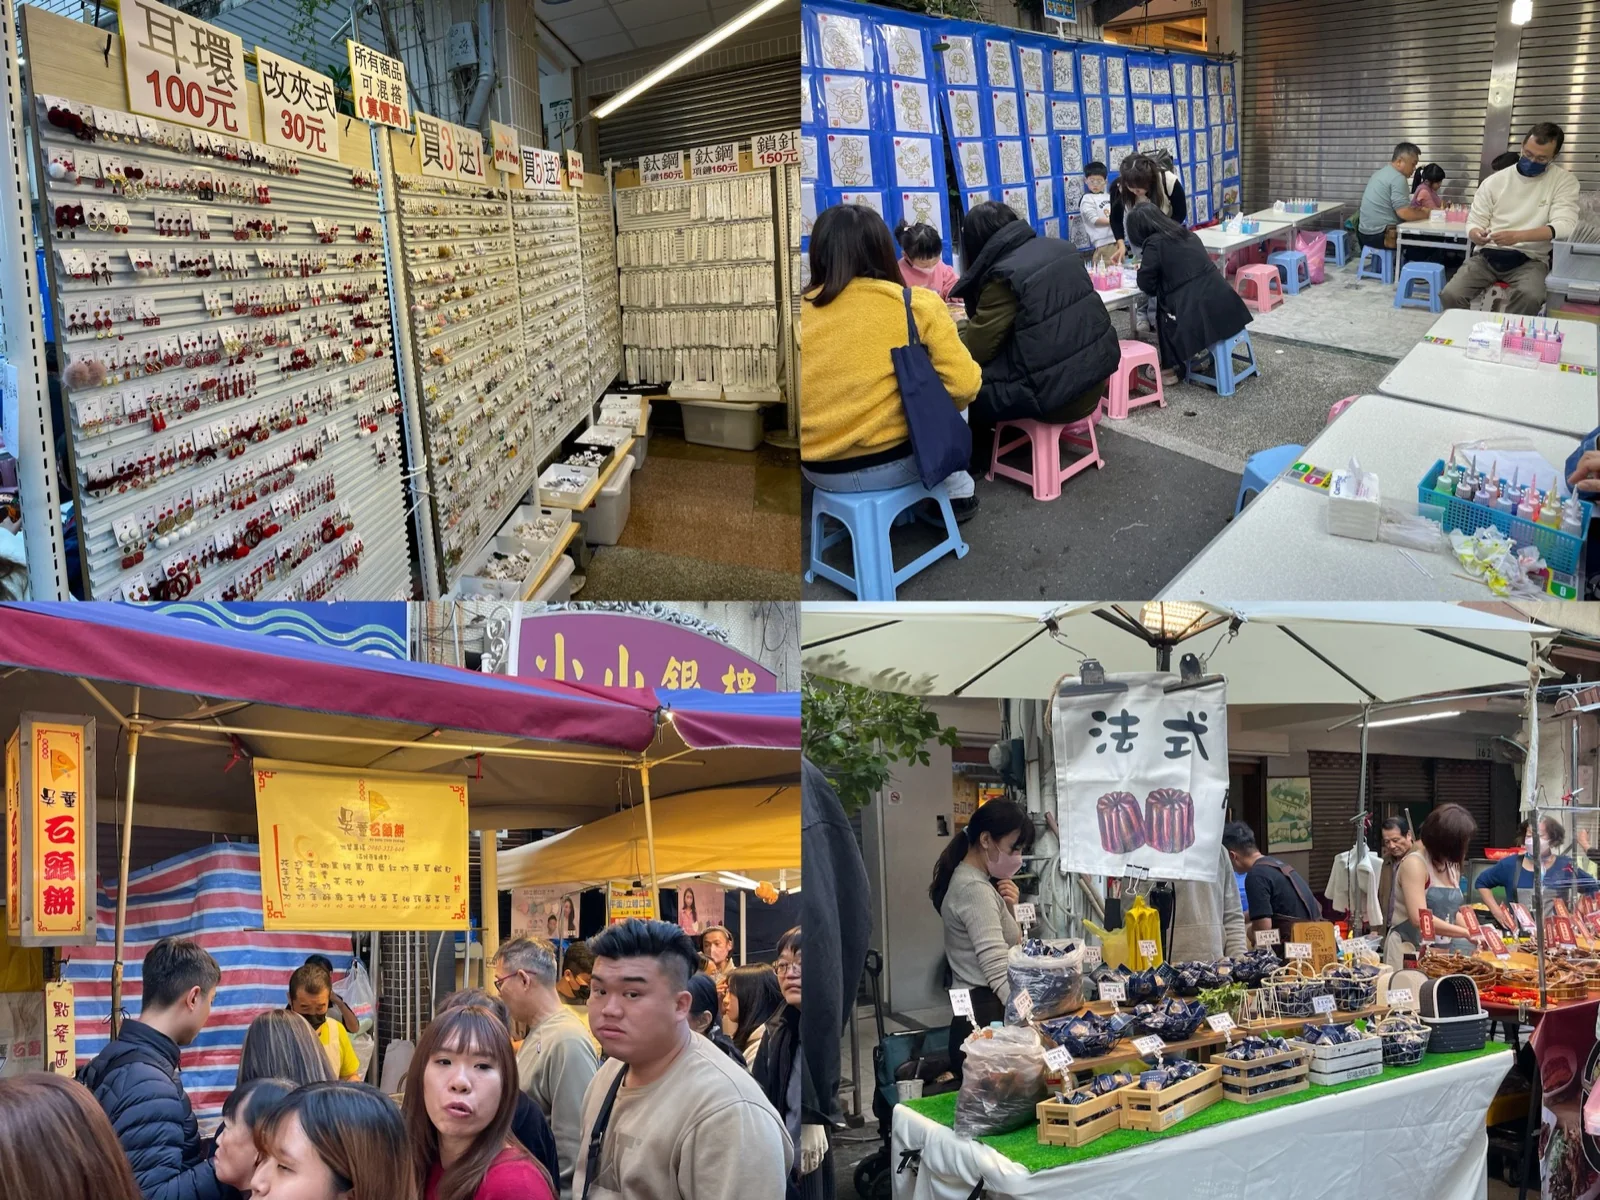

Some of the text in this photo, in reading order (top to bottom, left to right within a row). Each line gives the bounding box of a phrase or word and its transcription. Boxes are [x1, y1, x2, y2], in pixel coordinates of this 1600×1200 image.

[134, 1, 238, 91] 耳環
[354, 46, 402, 82] 所有商品
[146, 69, 239, 132] 100元
[261, 59, 335, 119] 改夾式
[361, 73, 402, 105] 可混搭
[280, 108, 327, 153] 30元
[554, 110, 570, 121] 197
[694, 144, 734, 165] 鈦鋼
[757, 131, 798, 155] 鎖針
[759, 149, 799, 165] 150元
[643, 151, 679, 173] 鈦鋼
[1088, 709, 1209, 761] 法式
[1478, 747, 1491, 758] 162
[43, 815, 76, 916] 石頭餅
